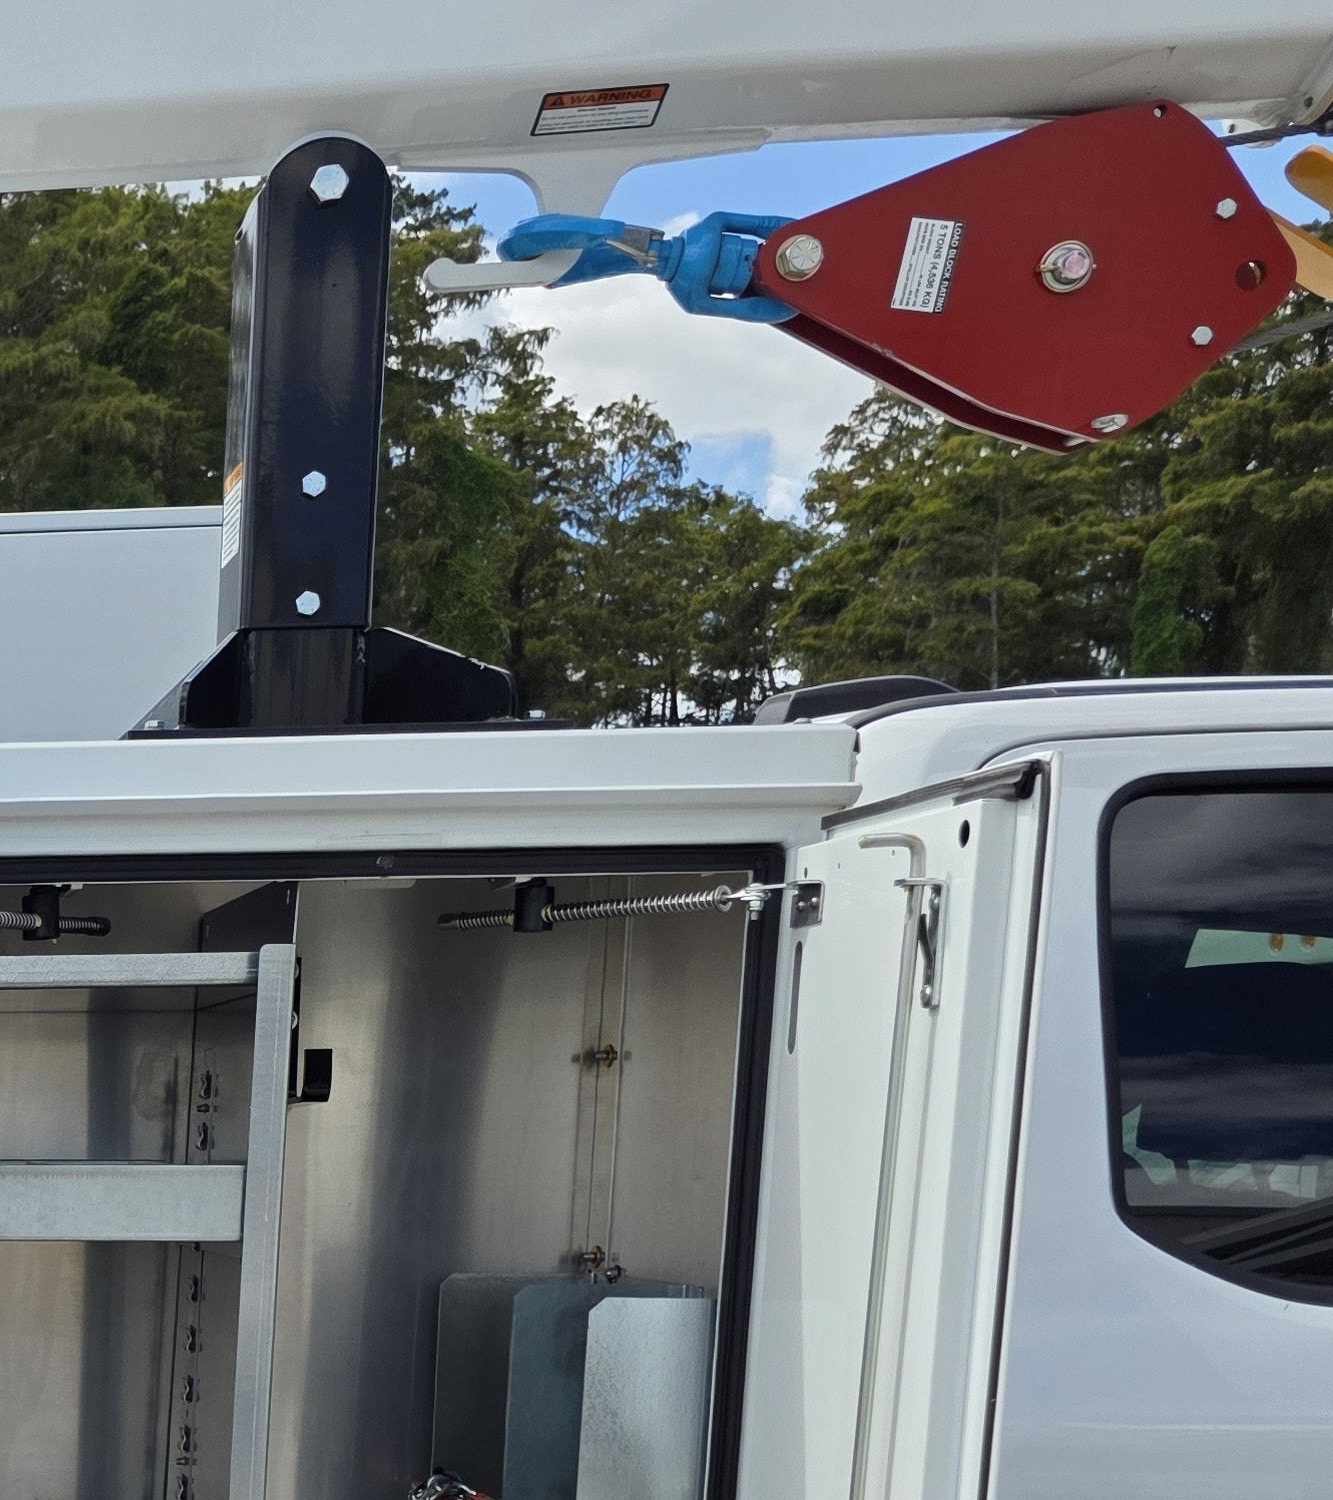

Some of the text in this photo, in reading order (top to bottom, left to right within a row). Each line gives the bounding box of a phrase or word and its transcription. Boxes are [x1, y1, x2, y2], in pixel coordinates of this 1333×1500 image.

[569, 89, 653, 105] WARNING
[932, 232, 947, 260] TONS
[934, 222, 963, 313] LOAD BLOCK RATING
